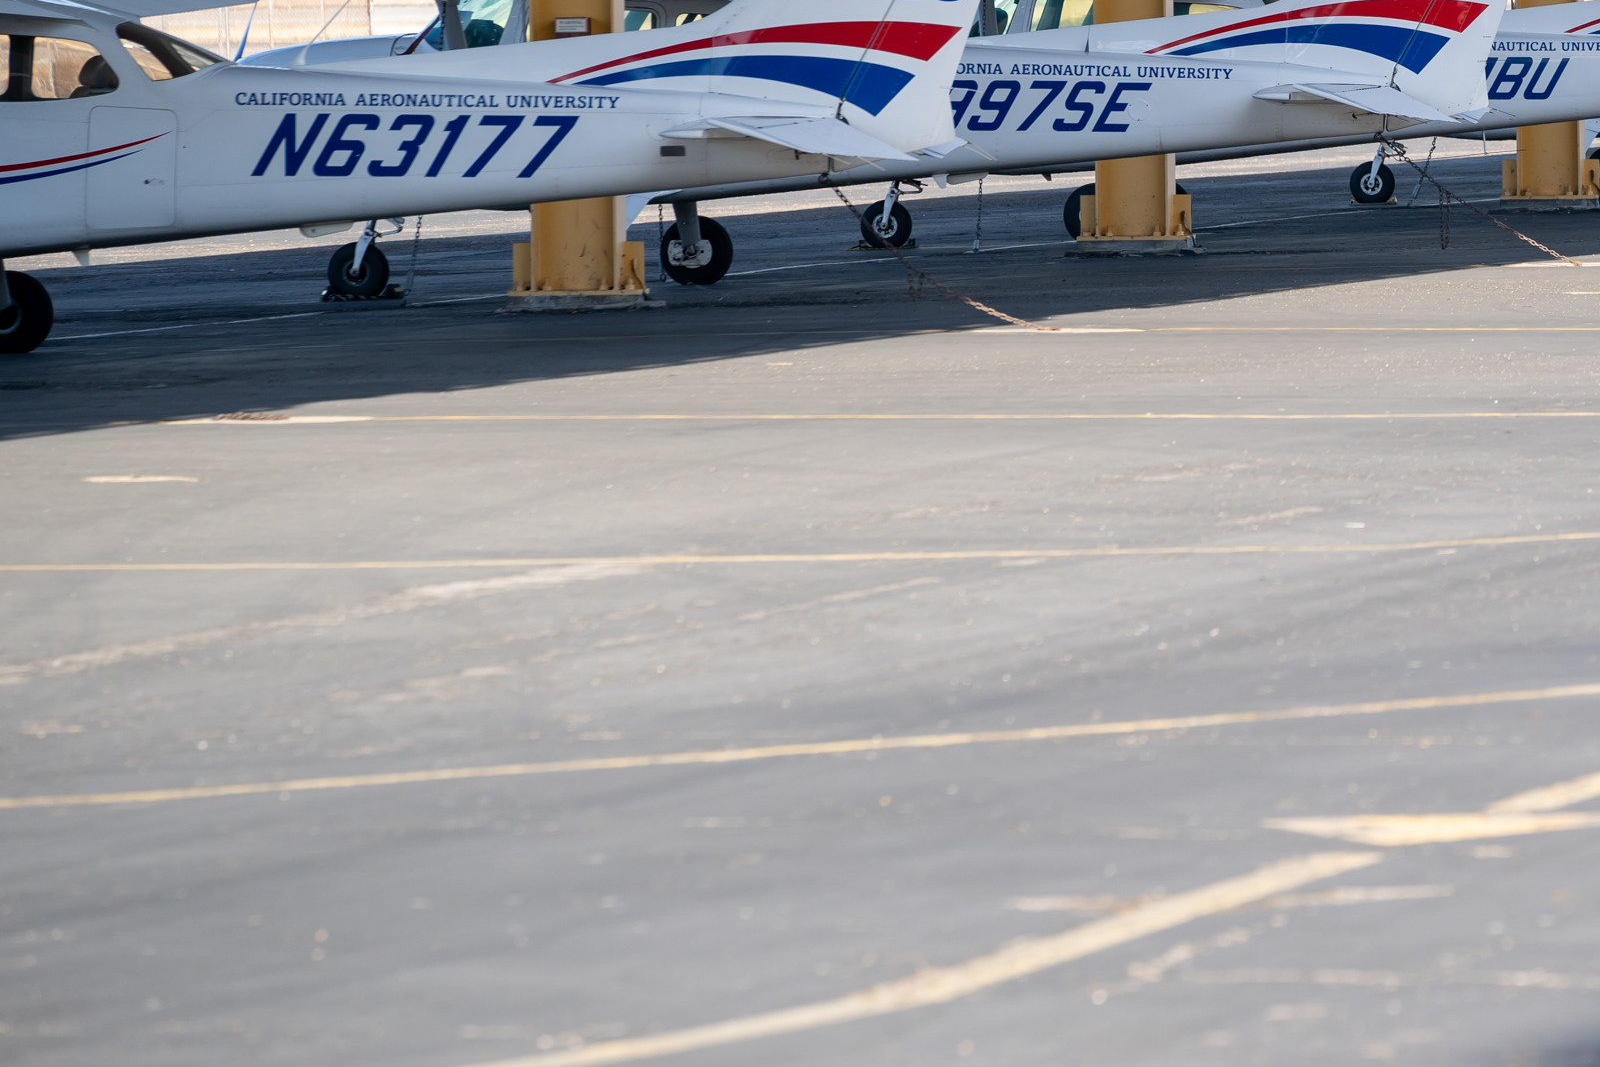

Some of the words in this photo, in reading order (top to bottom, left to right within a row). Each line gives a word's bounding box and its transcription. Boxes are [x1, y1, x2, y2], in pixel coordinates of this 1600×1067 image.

[1009, 63, 1131, 77] AERONAUTICAL
[1137, 66, 1233, 79] UNIVERSITY
[235, 92, 347, 107] CALIFORNIA
[355, 93, 499, 108] AERONAUTICAL
[506, 94, 620, 109] UNIVERSITY
[250, 112, 580, 179] N63177
